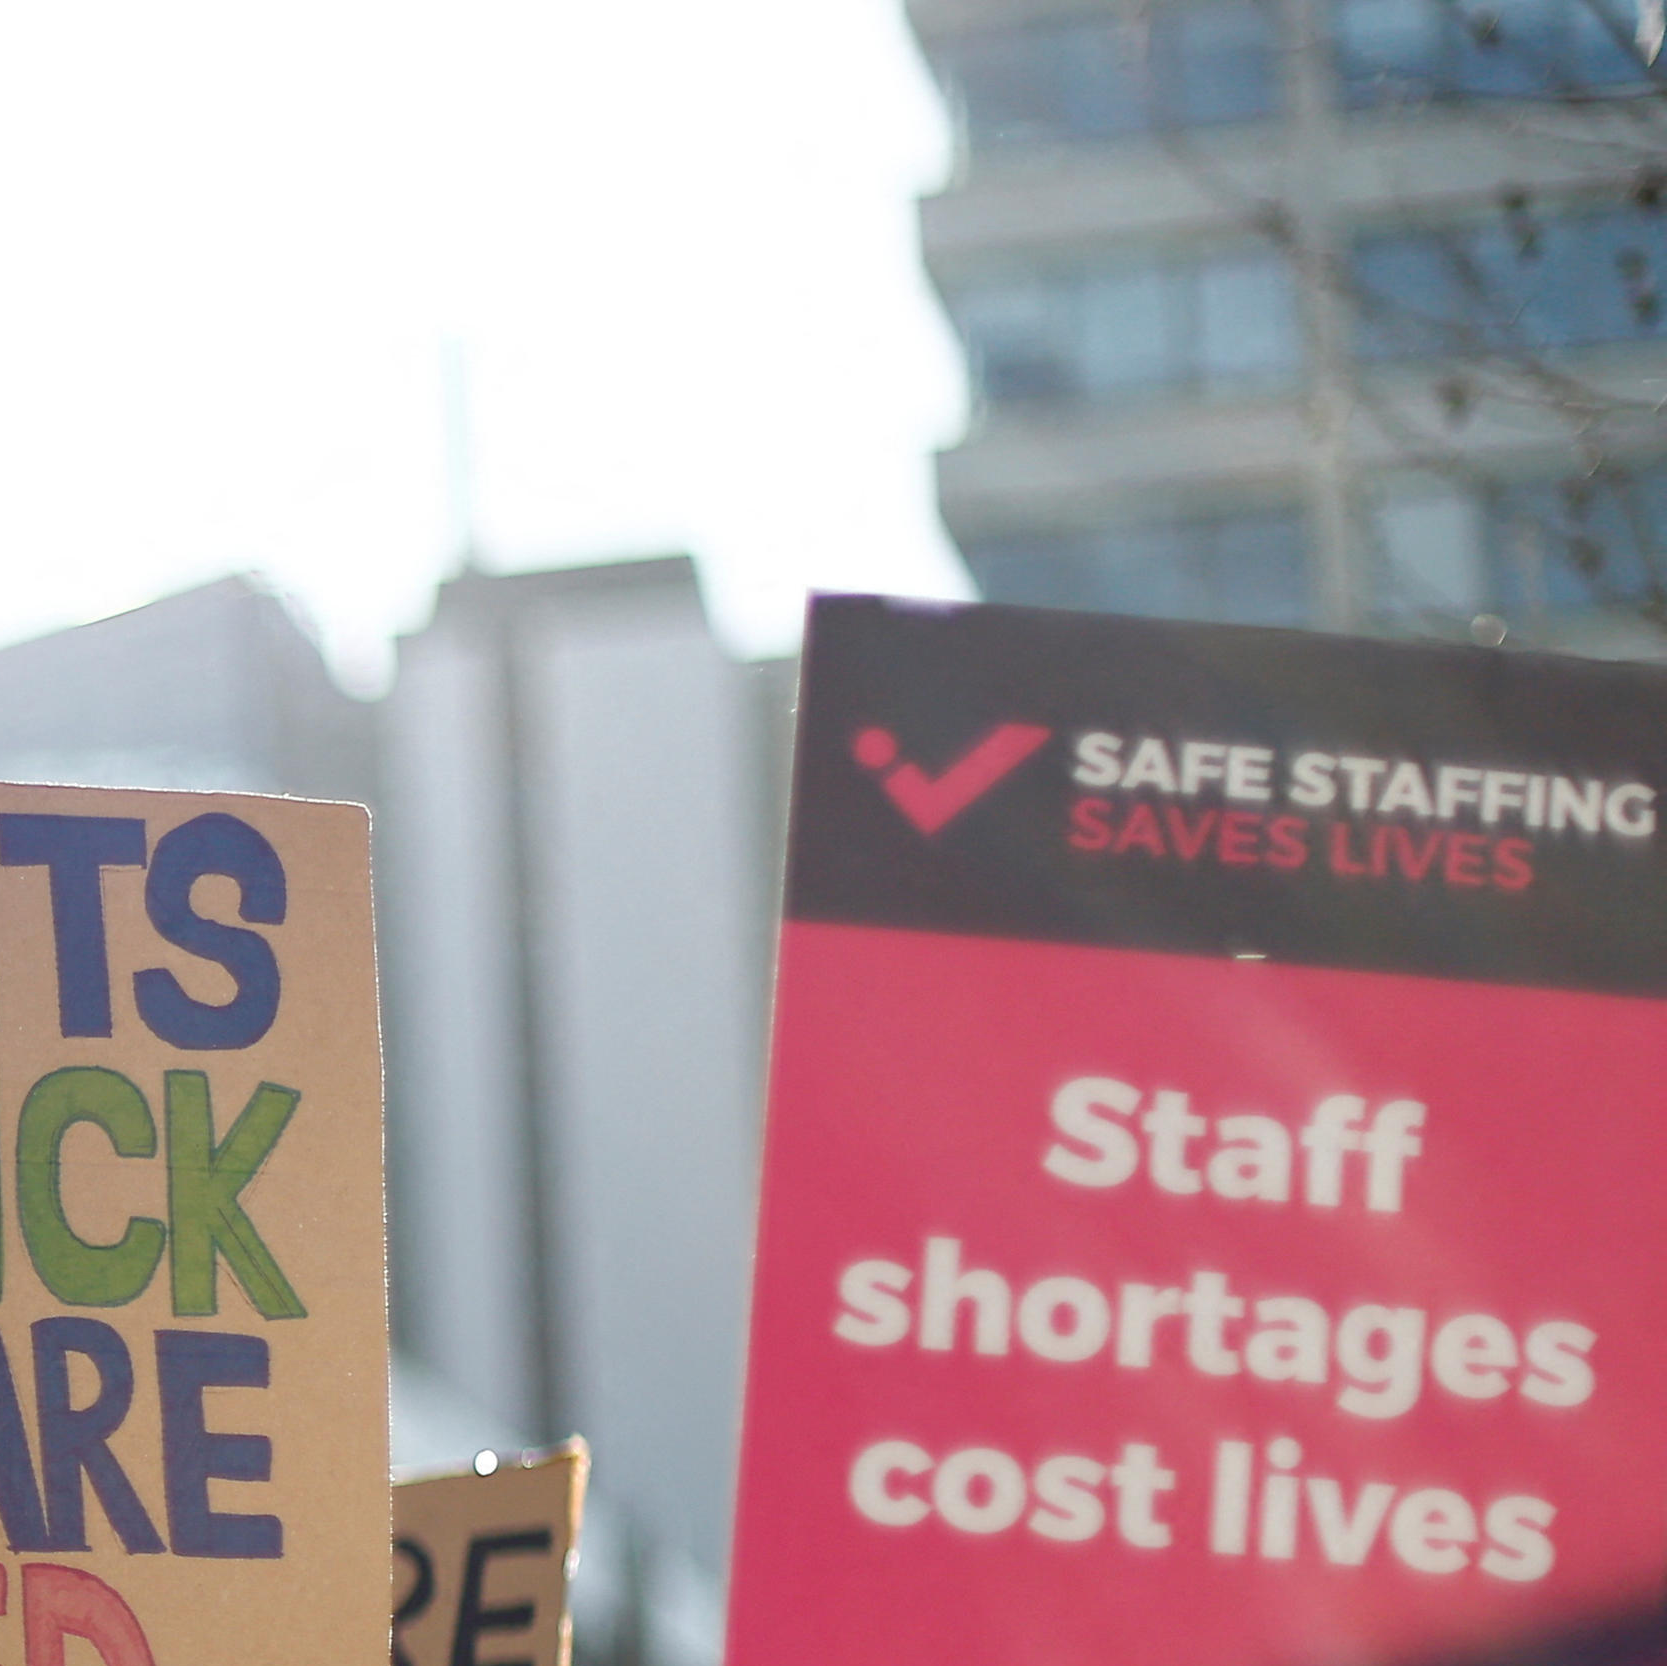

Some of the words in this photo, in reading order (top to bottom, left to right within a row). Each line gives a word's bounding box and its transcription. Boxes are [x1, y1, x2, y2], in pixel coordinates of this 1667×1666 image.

[1068, 797, 1311, 870] SAVES
[1325, 820, 1536, 891] LIVES
[1072, 730, 1274, 802] SAFE
[1286, 750, 1658, 838] STAFFING
[1042, 1073, 1428, 1214] Staff
[833, 1236, 1599, 1420] shortages
[848, 1437, 1176, 1554] cost
[1209, 1437, 1560, 1583] lives
